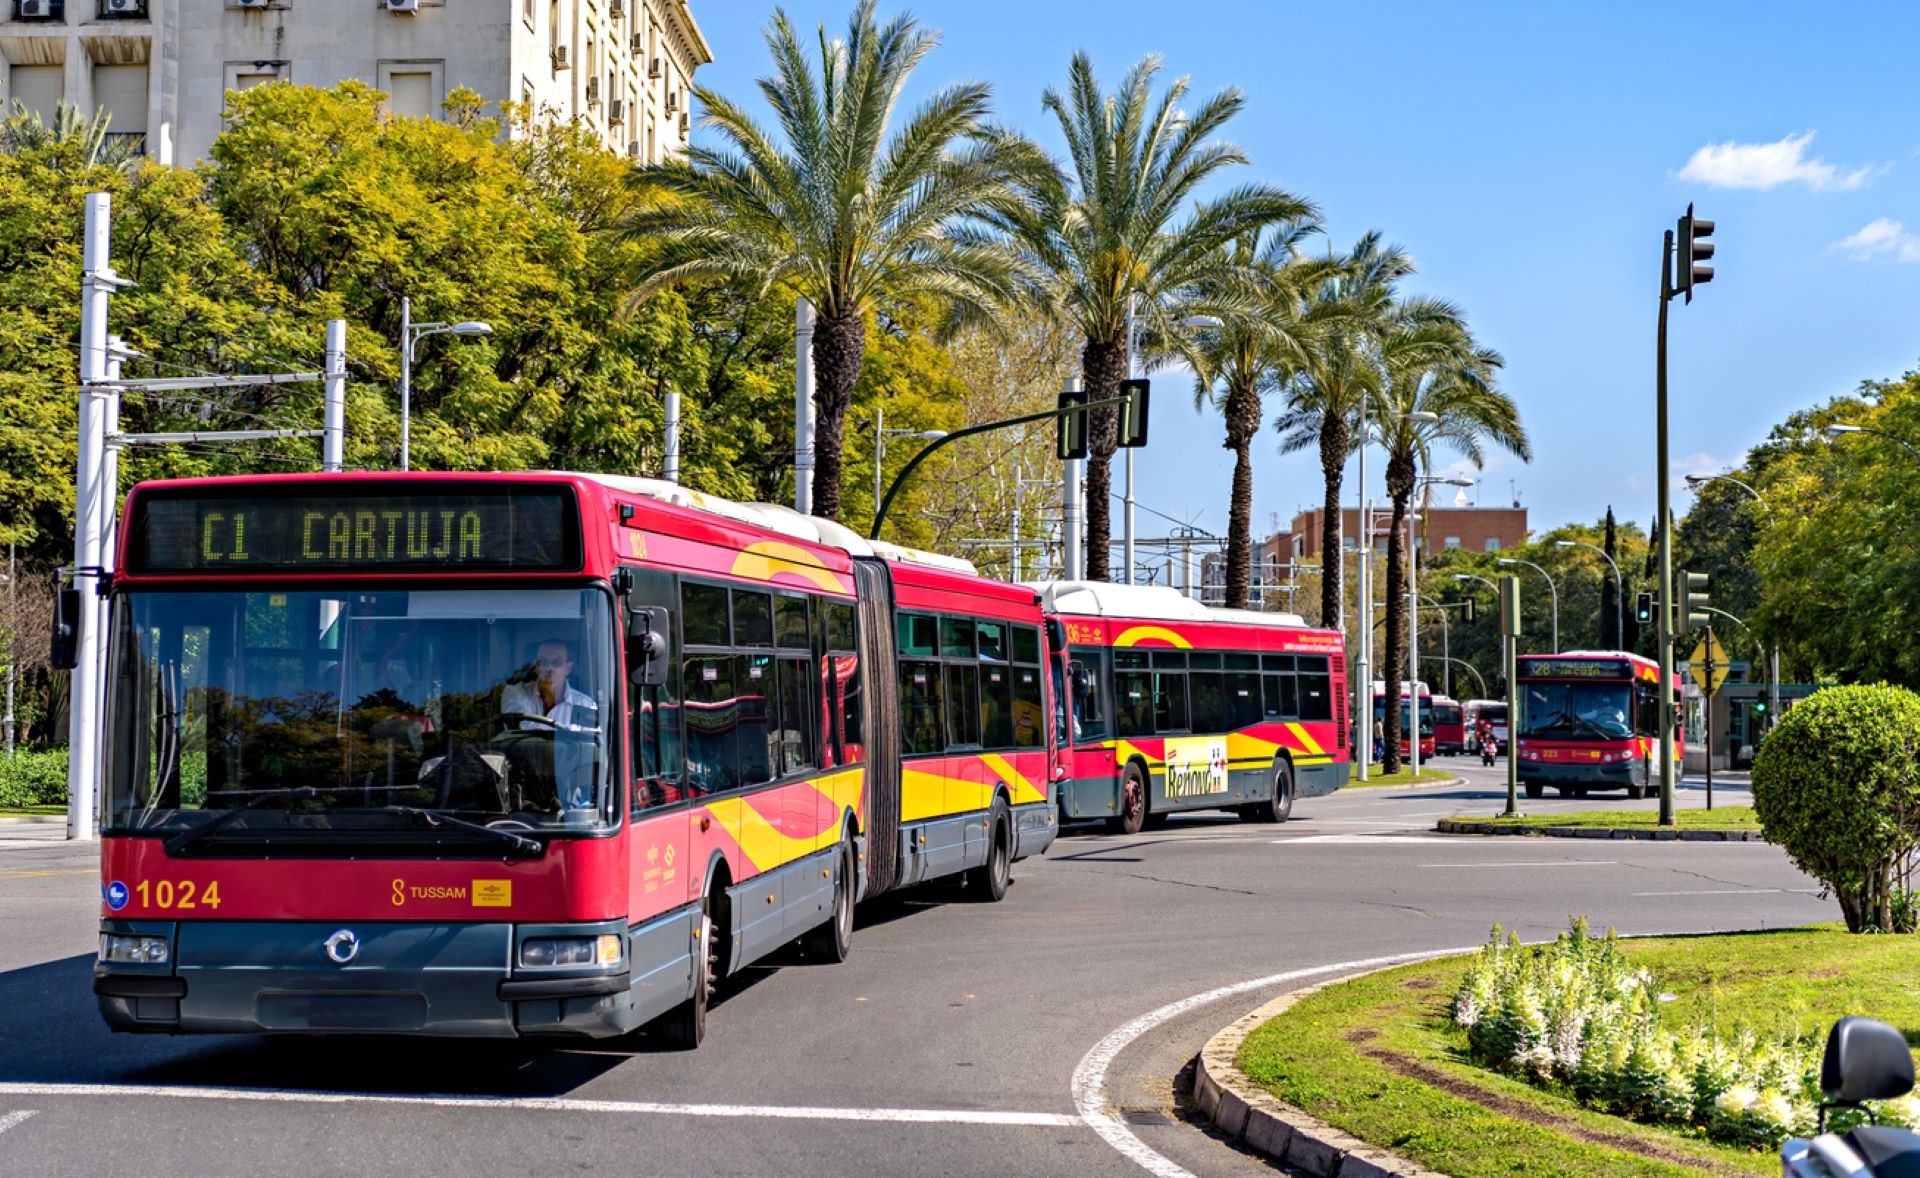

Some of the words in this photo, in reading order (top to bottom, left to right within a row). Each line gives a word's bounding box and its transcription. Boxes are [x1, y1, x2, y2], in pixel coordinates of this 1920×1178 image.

[203, 513, 249, 560] C1
[303, 511, 481, 560] CARTUJA
[136, 879, 221, 910] 1024
[409, 886, 467, 899] TUSSAM
